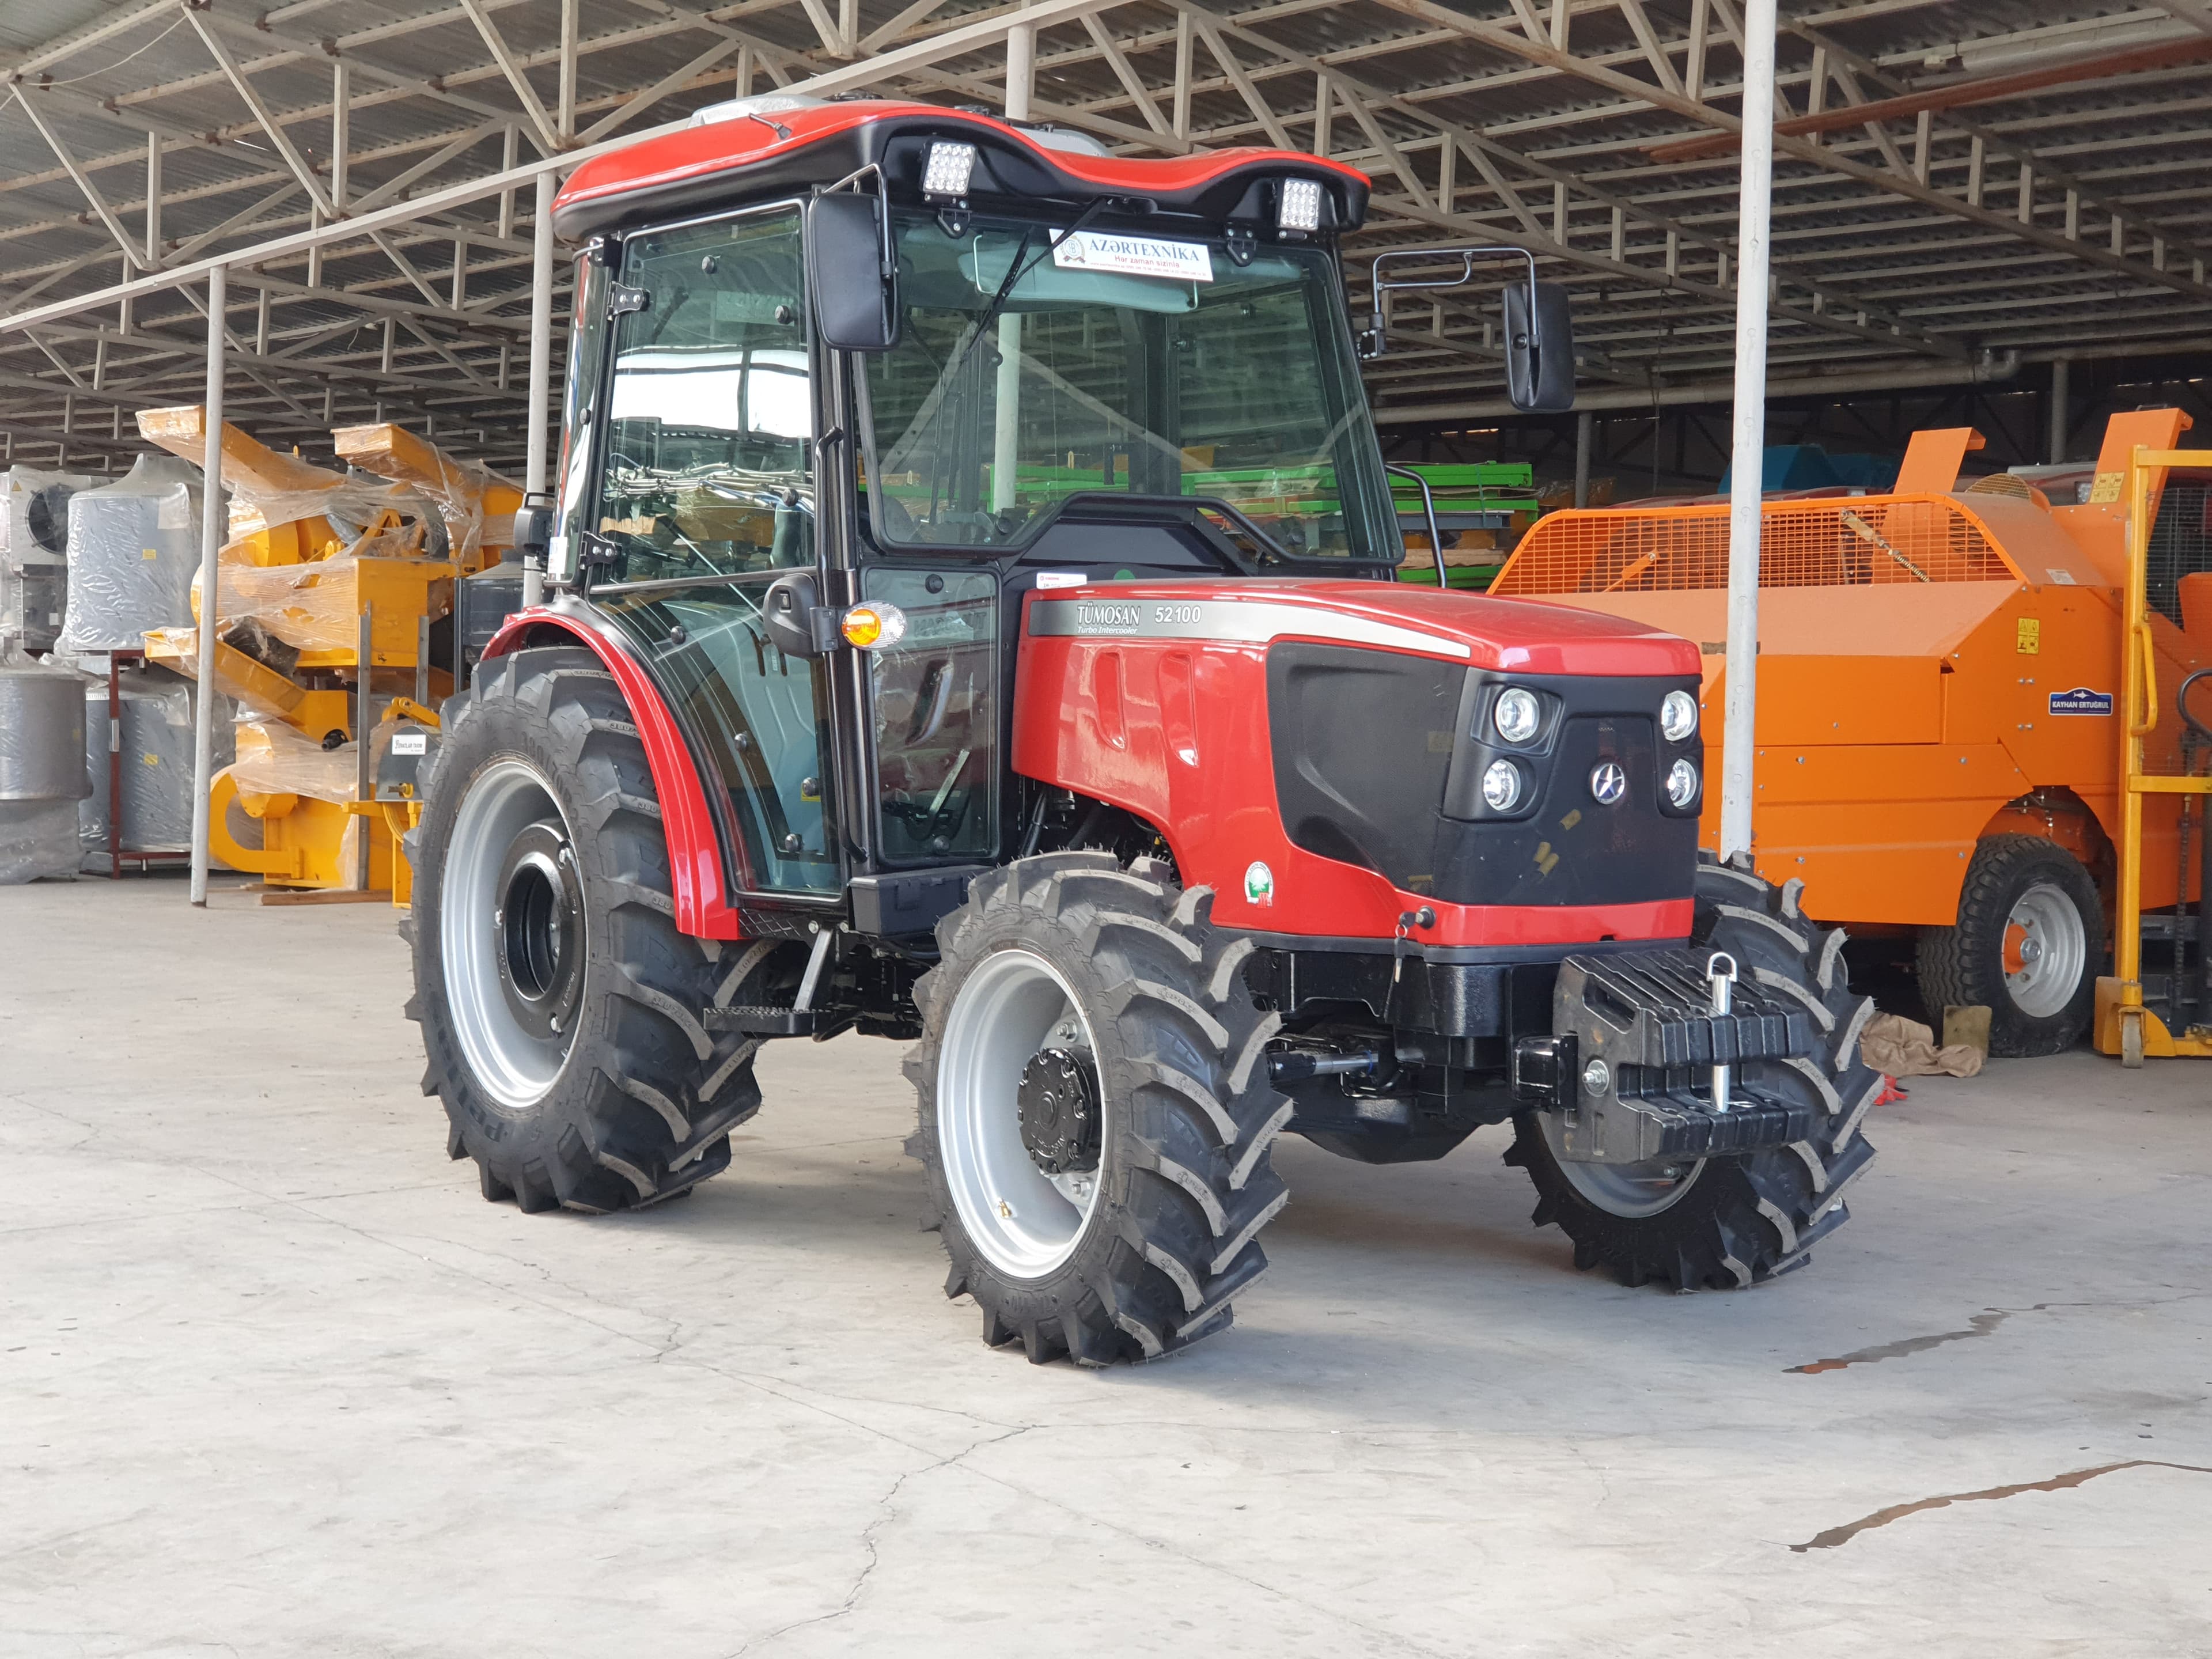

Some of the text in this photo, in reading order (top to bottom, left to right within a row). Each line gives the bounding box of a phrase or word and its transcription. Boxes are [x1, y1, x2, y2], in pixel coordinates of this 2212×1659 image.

[1089, 238, 1199, 262] AZƏRTEXNİKA
[1130, 257, 1154, 266] zaman
[1077, 601, 1141, 626] TÜMOSAN
[1098, 626, 1138, 634] Intercooler
